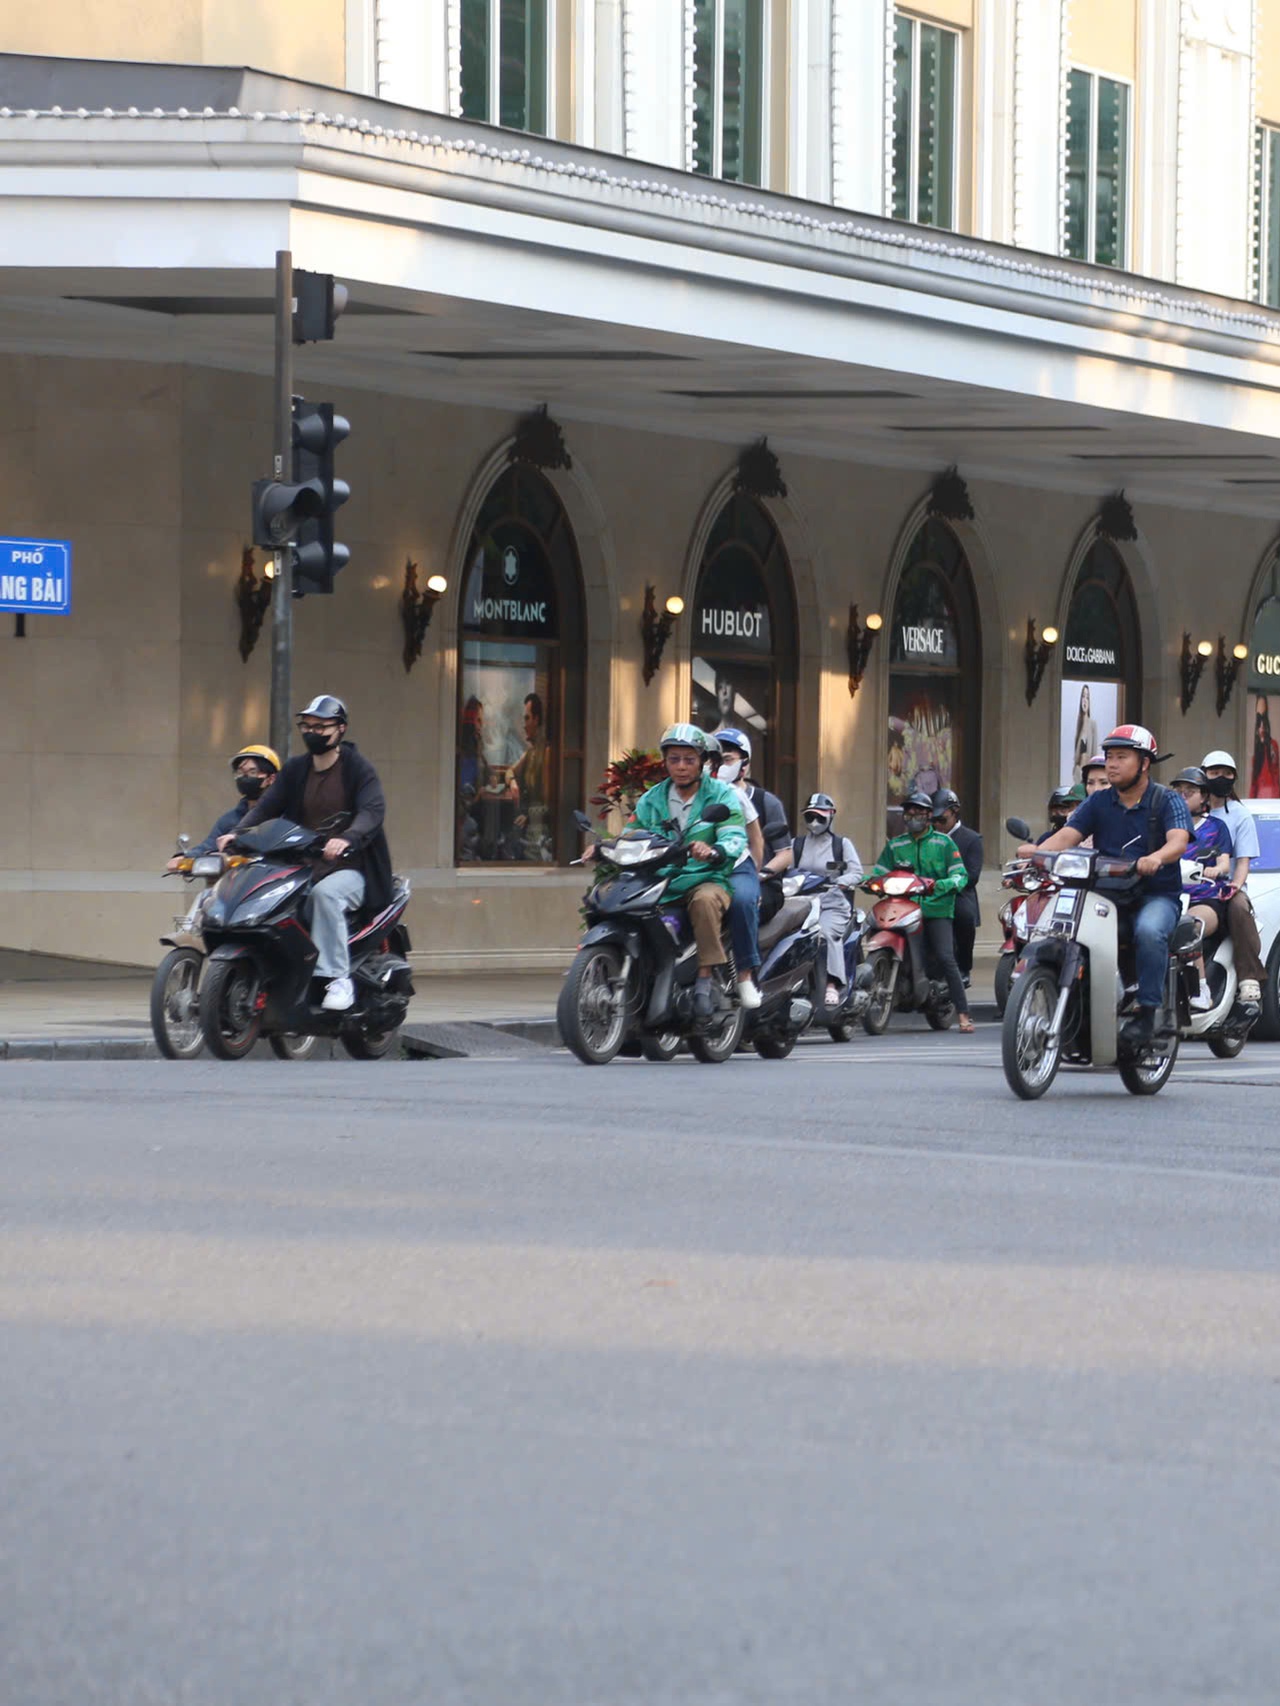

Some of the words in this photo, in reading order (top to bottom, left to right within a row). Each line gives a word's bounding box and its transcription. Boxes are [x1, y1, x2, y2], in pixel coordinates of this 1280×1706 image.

[0, 575, 27, 601] NG
[31, 571, 63, 603] BÀI
[473, 598, 547, 623] MONTBLANC
[701, 608, 763, 638] HUBLOT
[902, 625, 944, 654] VERSACE
